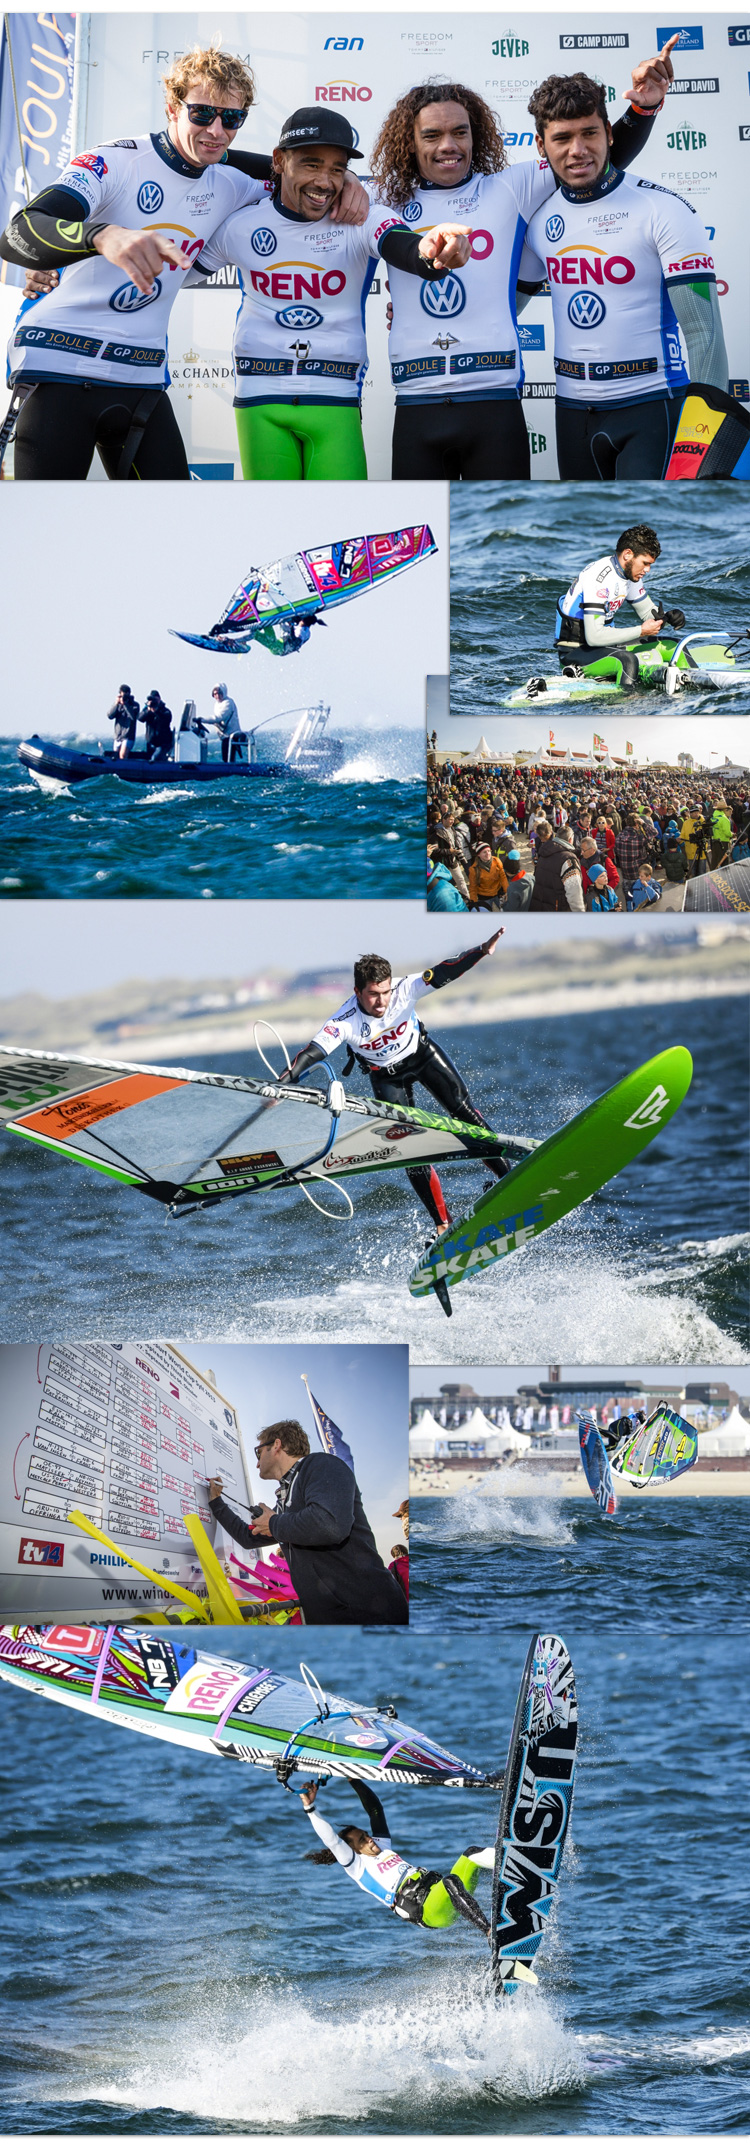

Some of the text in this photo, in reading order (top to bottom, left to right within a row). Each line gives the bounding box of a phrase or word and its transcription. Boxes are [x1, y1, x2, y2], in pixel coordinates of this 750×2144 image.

[323, 36, 364, 51] ran
[400, 33, 453, 41] FREEDOM
[578, 35, 626, 47] CAMP DAVID
[491, 38, 530, 58] JEVER
[485, 79, 538, 88] FREEDOM
[691, 79, 716, 92] DAVID
[315, 86, 373, 102] RENO
[666, 130, 707, 151] JEVER
[661, 171, 717, 180] FREEDOM
[587, 211, 629, 225] FREEDOM
[598, 220, 616, 228] SPORT
[304, 230, 344, 242] FREEDOM
[316, 238, 333, 246] SPORT
[546, 255, 636, 286] RENO
[667, 255, 715, 273] RENO
[250, 269, 347, 301] RENO
[25, 329, 94, 350] GP JOULE
[113, 347, 161, 361] GP JOULE
[666, 332, 683, 372] ran
[239, 359, 285, 372] GP JOULE
[305, 361, 352, 375] GP JOULE
[394, 359, 438, 376] GP JOULE
[457, 354, 511, 367] GP JOULE
[559, 361, 579, 374] JOULE
[595, 360, 649, 375] GP JOULE
[172, 369, 180, 379] &
[532, 384, 556, 397] DAVID
[359, 1020, 408, 1051] RENO
[220, 1153, 263, 1166] BELOW
[421, 1203, 545, 1269] SKATE
[410, 1224, 537, 1290] SKATE
[135, 1357, 160, 1382] RENO
[22, 1541, 61, 1564] tv14
[146, 1658, 172, 1688] NB
[186, 1670, 240, 1711] RENO
[237, 1678, 277, 1713] CHIEMSEE
